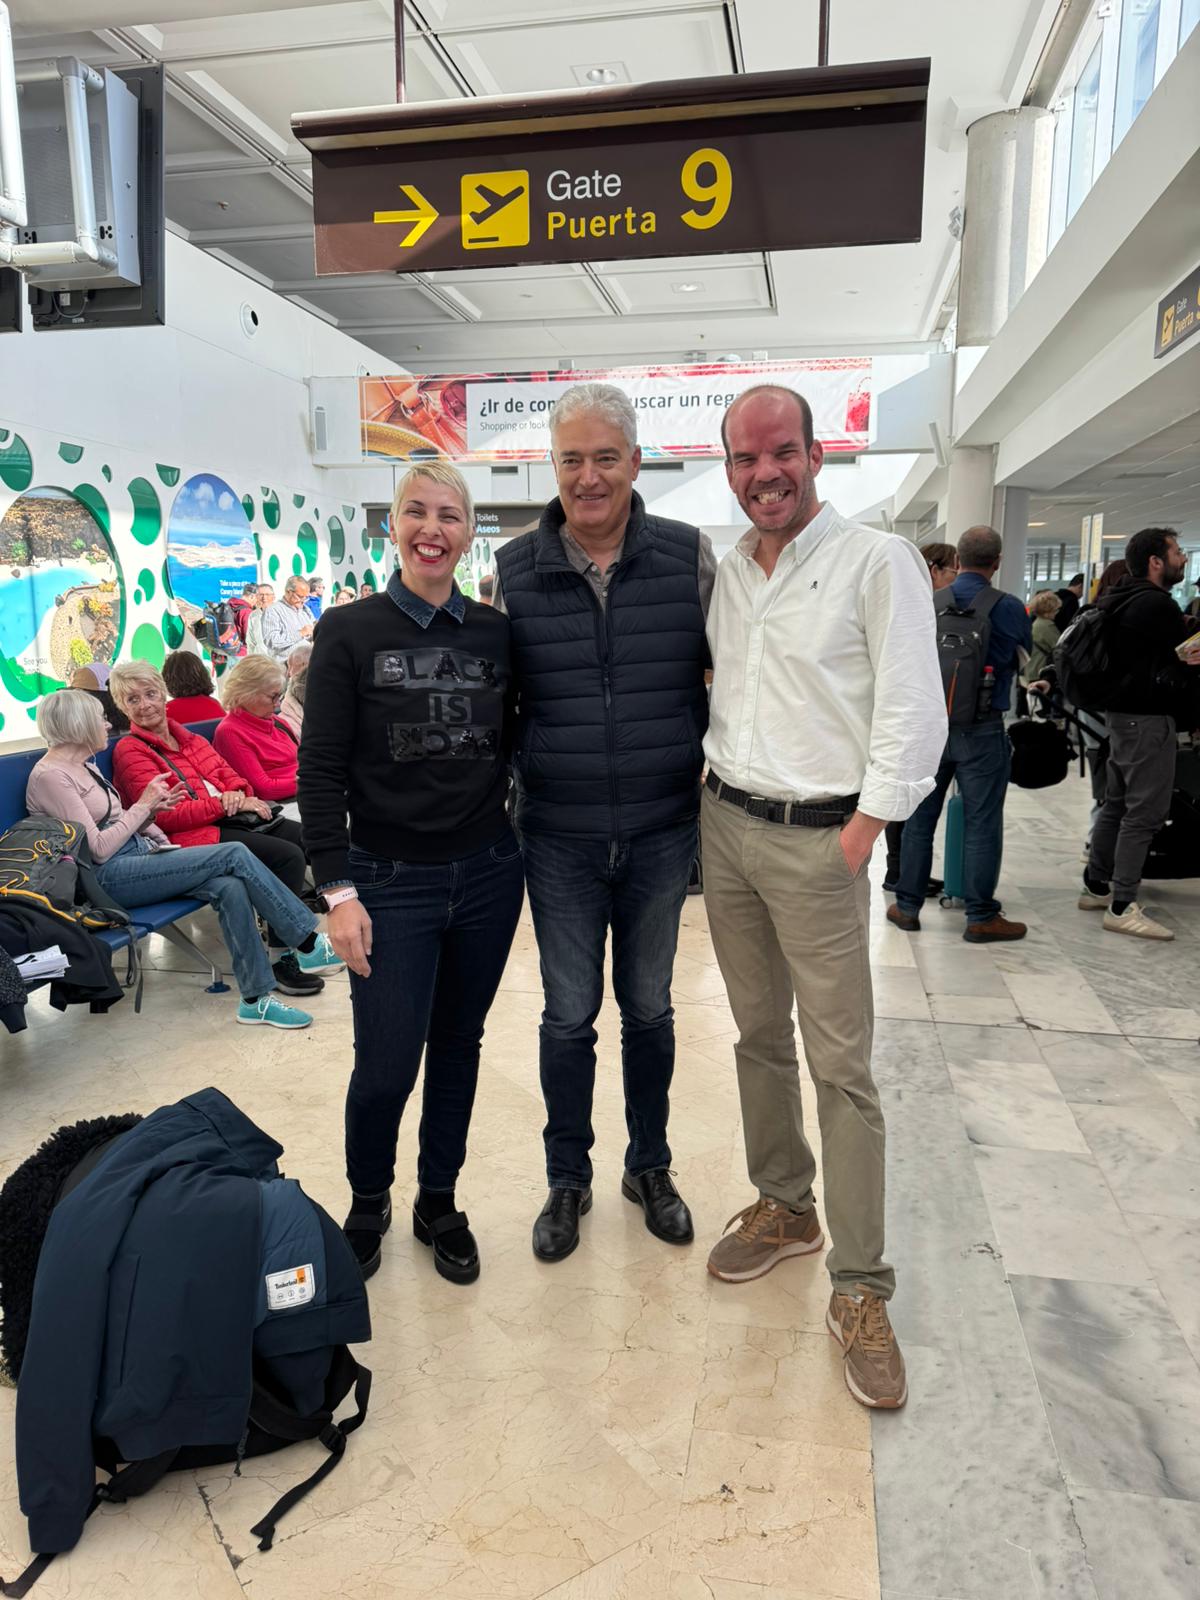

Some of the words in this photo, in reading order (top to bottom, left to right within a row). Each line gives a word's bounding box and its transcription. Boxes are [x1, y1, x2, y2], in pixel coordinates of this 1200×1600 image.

[546, 169, 623, 202] Gate
[680, 147, 733, 230] 9
[547, 206, 657, 241] Puerta
[479, 398, 500, 417] ¿Ir
[504, 397, 524, 413] de
[630, 395, 674, 409] uscar
[680, 394, 700, 407] un
[706, 393, 736, 409] reg
[480, 421, 517, 433] Shopping
[519, 422, 528, 430] or
[529, 420, 547, 430] look
[476, 513, 499, 522] Toilets
[476, 524, 501, 534] Aseos
[382, 650, 499, 689] BLACK
[433, 695, 468, 722] IS
